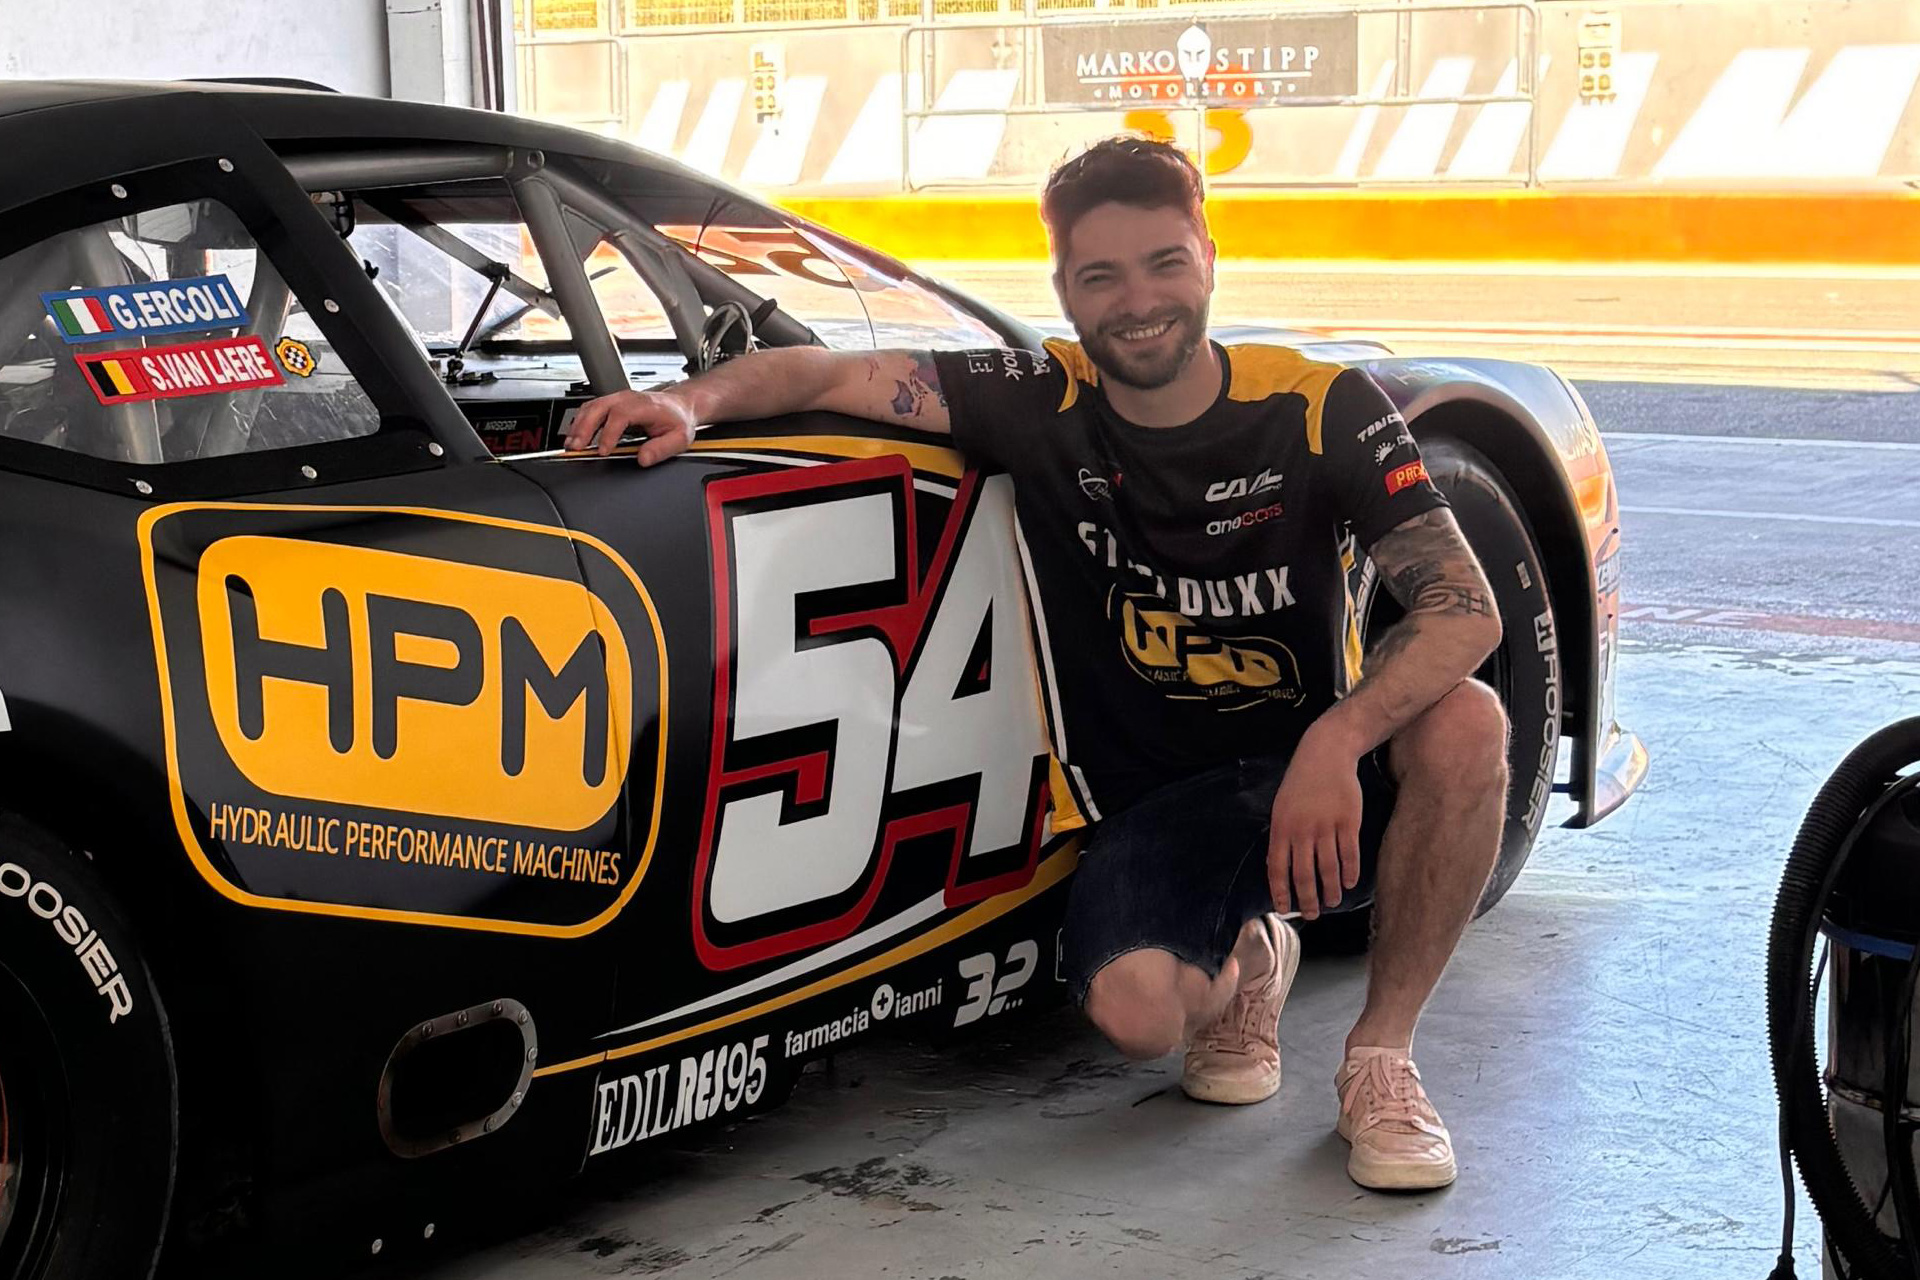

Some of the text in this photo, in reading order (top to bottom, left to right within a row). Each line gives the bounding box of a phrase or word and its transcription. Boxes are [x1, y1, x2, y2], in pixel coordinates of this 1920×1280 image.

[1076, 46, 1320, 77] MARKO STIPP
[1108, 80, 1283, 100] MOTORSPORT
[108, 283, 240, 329] G.ERCOLI
[140, 344, 275, 392] S.VAN LAERE
[224, 573, 610, 789] HPM
[709, 472, 1050, 925] 54
[1520, 652, 1563, 832] HOOSIER
[210, 802, 622, 887] HYDRAULIC PERFORMANCE MACHINES
[784, 1005, 870, 1059] farmacia
[589, 1034, 770, 1157] EDILRES95
